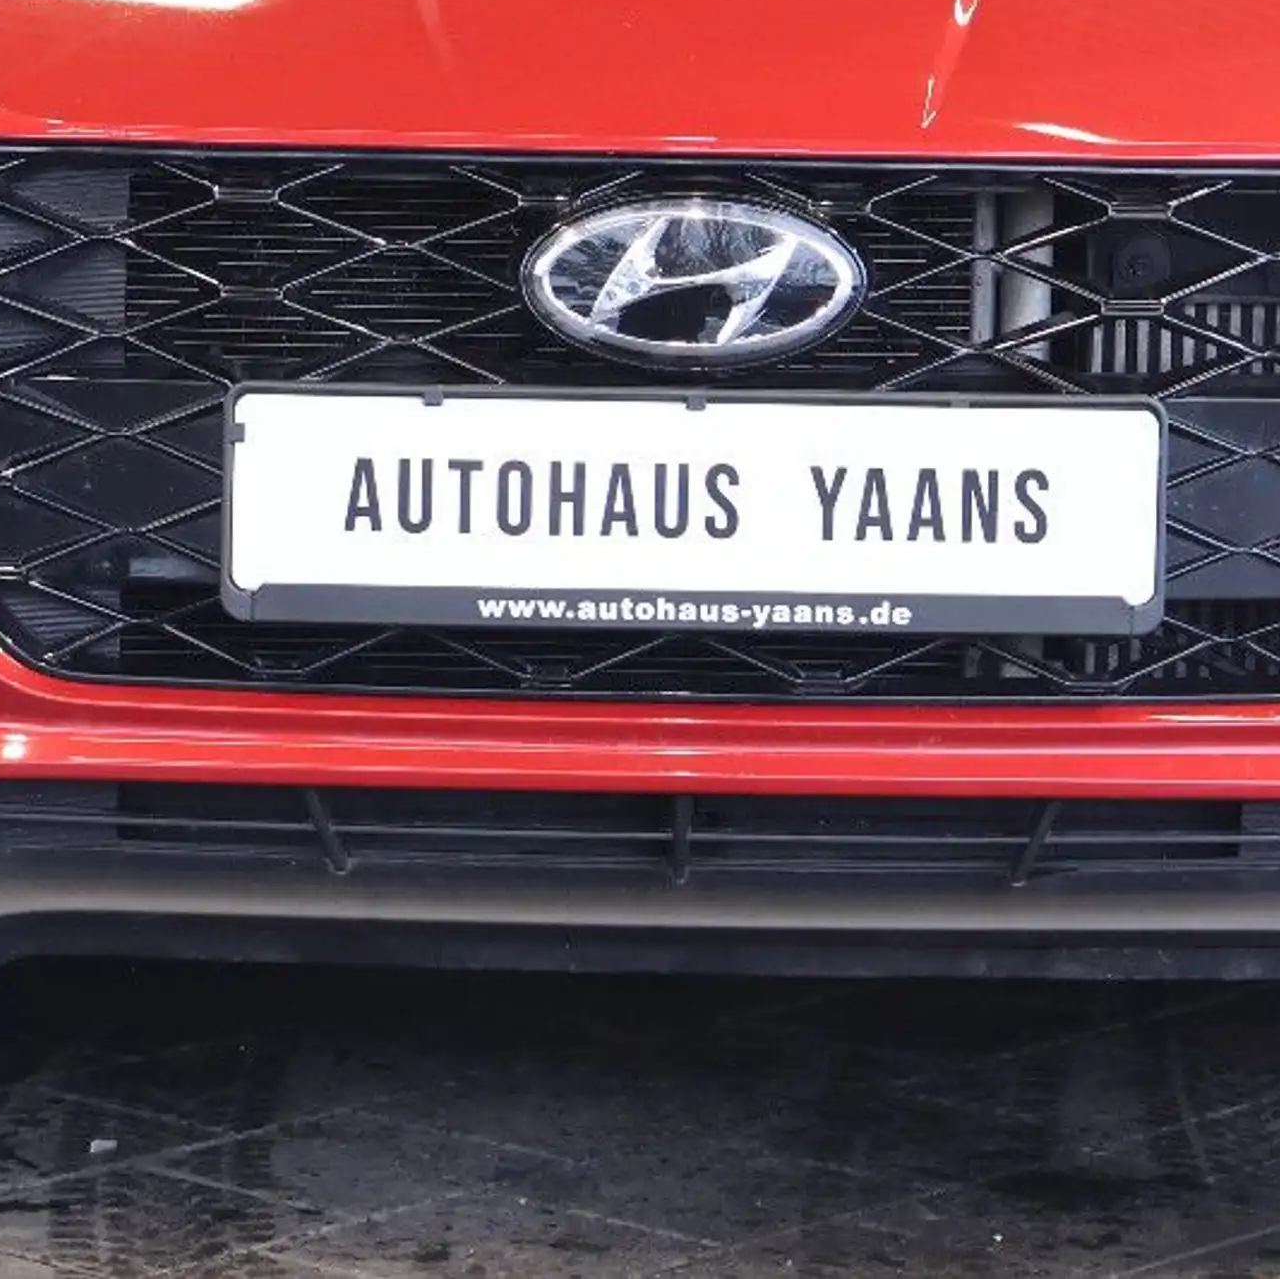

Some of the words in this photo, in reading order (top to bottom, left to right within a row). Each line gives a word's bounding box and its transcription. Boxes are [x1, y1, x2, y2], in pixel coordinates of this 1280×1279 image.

[344, 457, 740, 538] AUTOHAUS
[810, 466, 1050, 543] YAANS
[476, 597, 913, 628] www.autohaus-yaans.de
